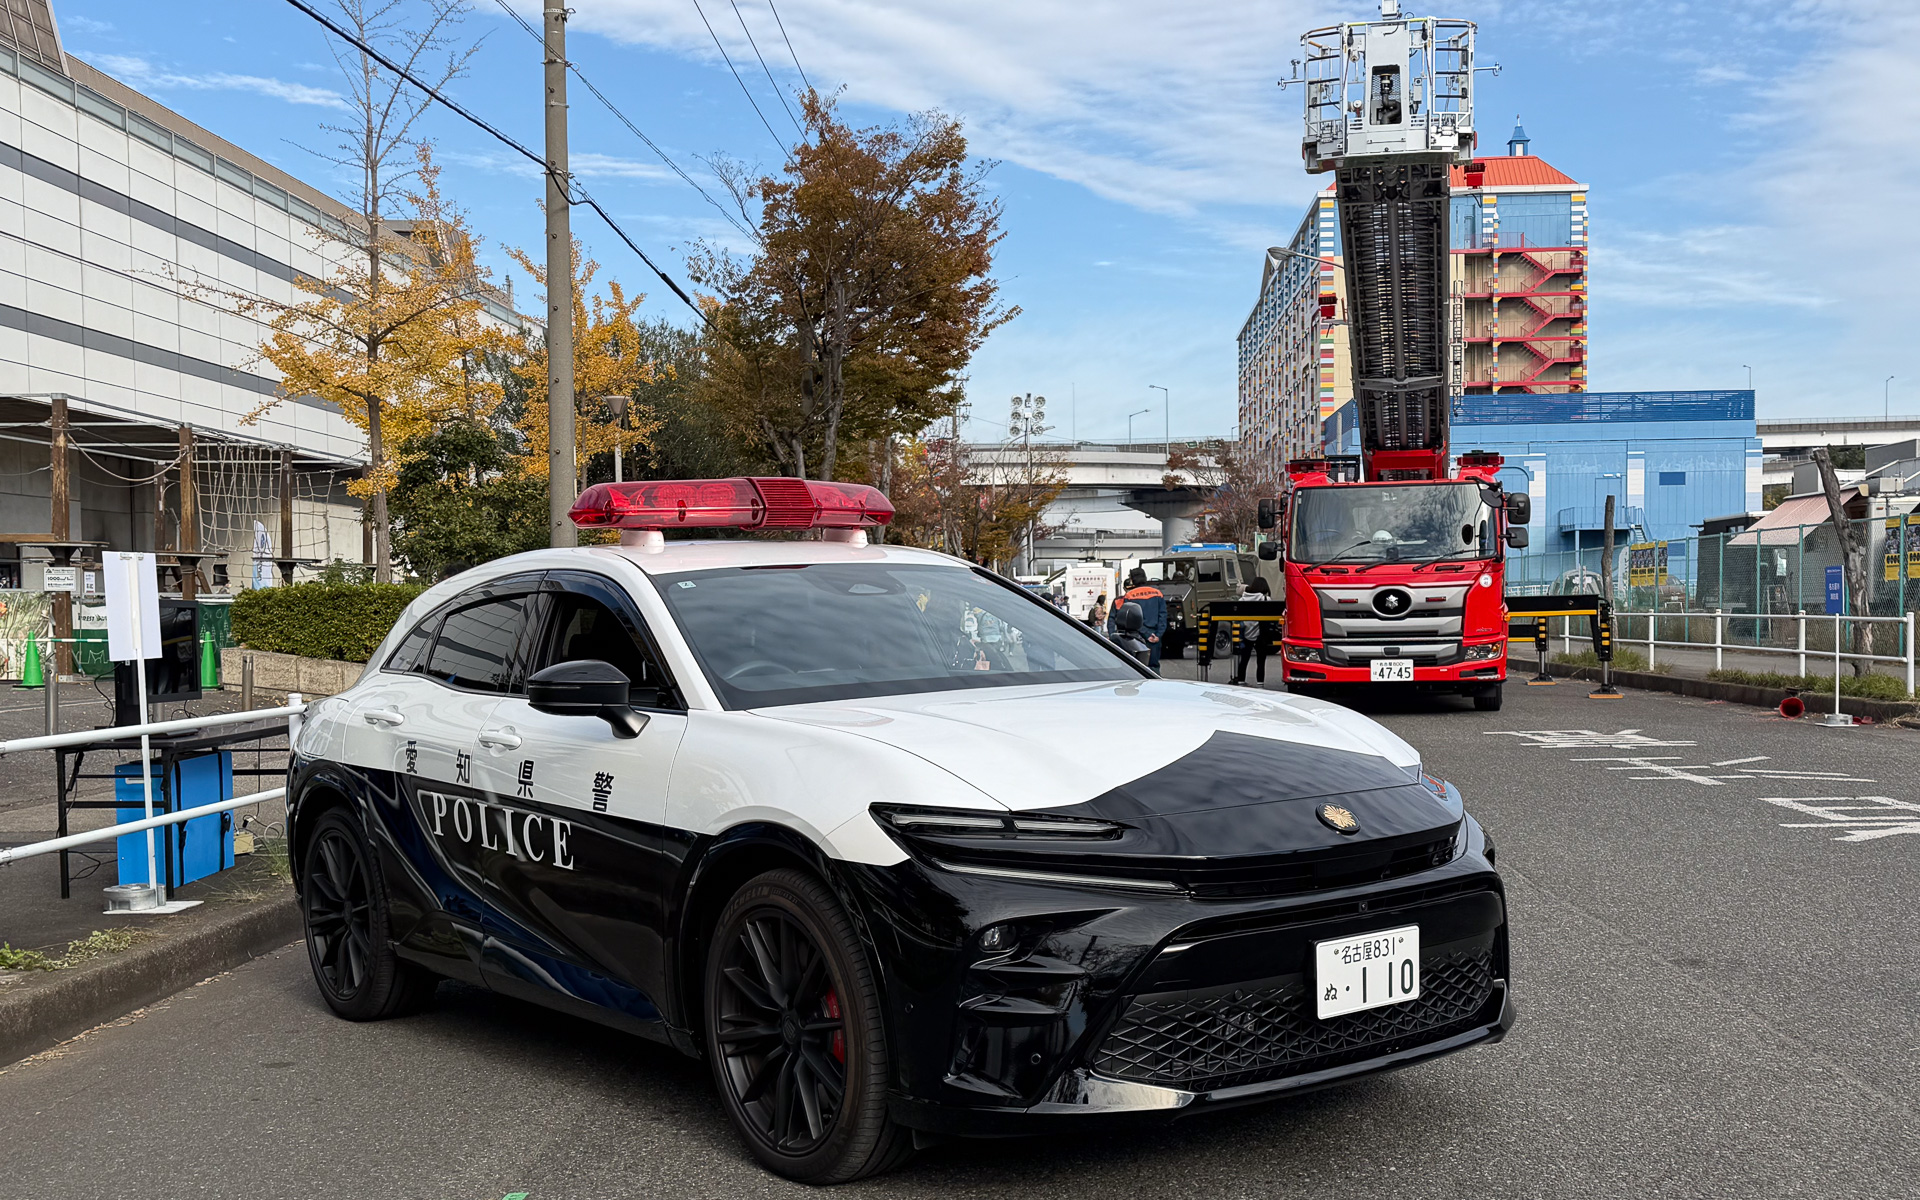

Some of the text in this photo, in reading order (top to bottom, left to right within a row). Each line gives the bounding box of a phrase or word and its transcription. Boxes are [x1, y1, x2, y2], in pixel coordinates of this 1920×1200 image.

[405, 740, 615, 812] 愛知県警
[431, 791, 574, 871] POLICE
[1341, 936, 1395, 965] 名古屋831
[1324, 983, 1338, 1001] ぬ
